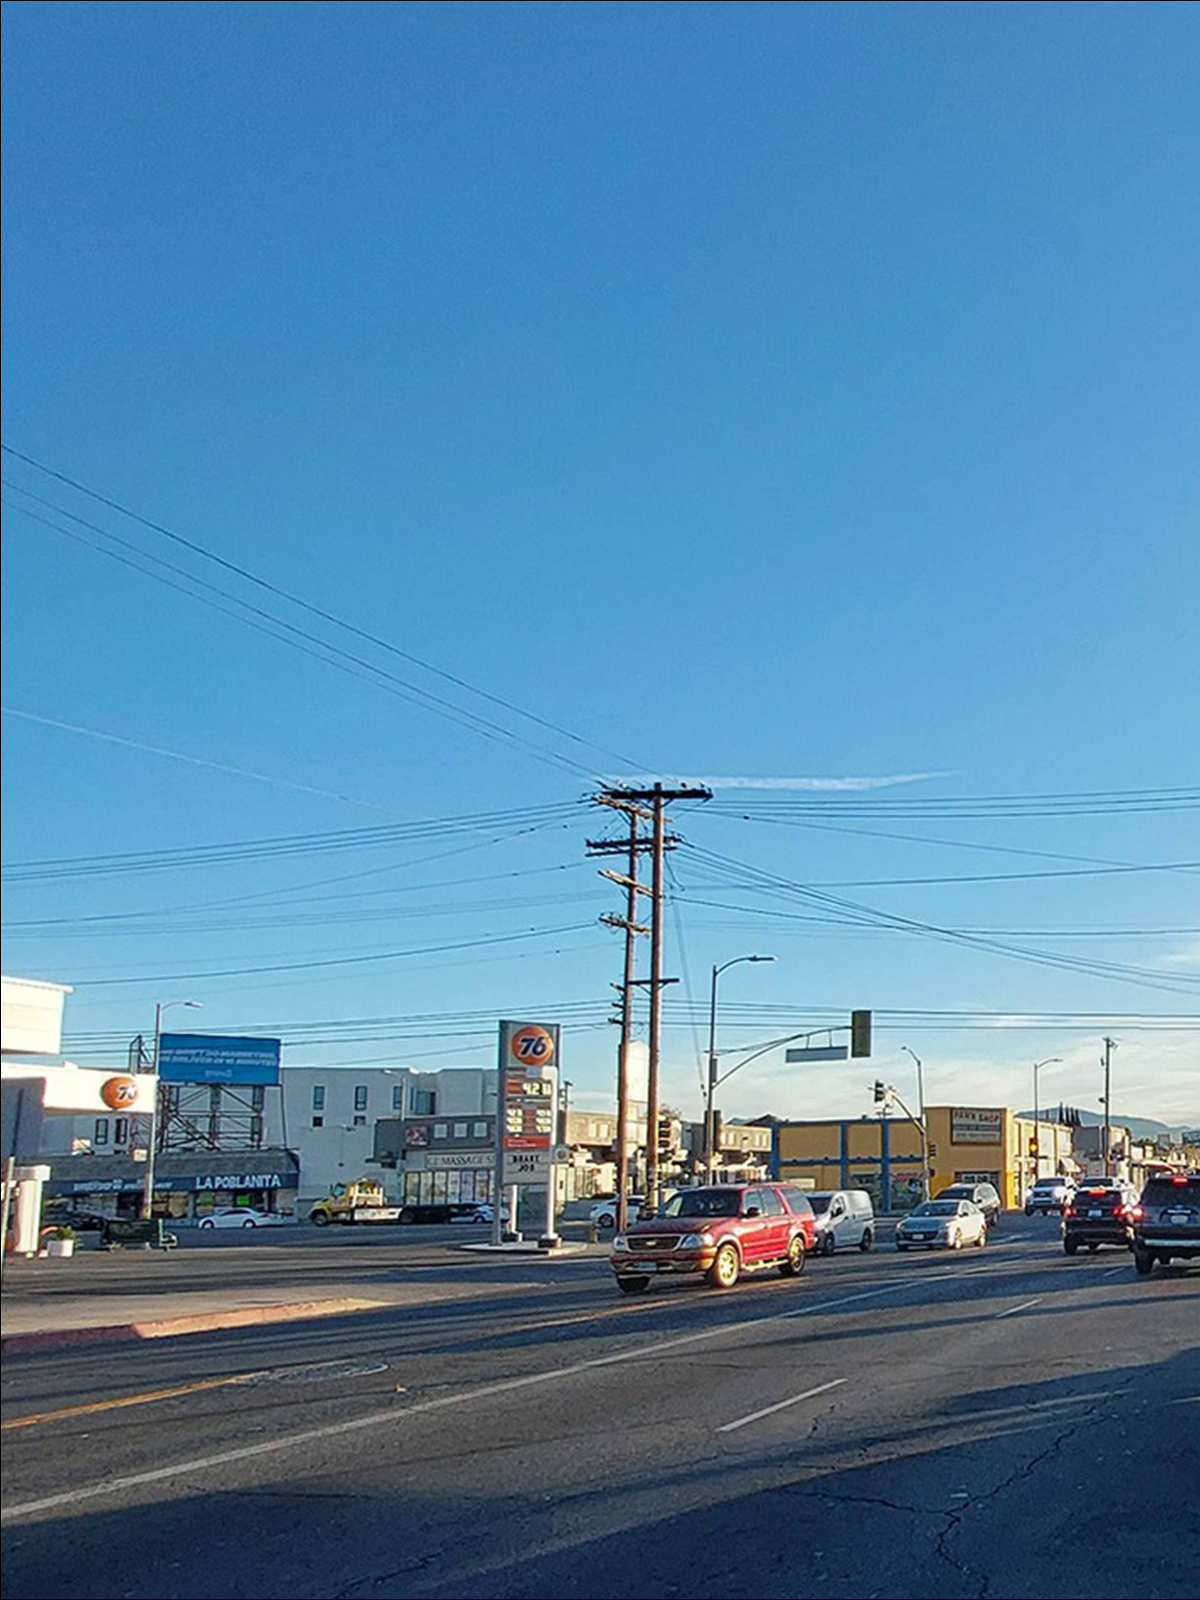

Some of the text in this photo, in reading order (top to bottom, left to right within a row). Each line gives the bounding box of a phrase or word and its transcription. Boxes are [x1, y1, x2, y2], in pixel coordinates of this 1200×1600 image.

[517, 1034, 548, 1058] 76
[512, 1154, 540, 1164] BRAKE
[518, 1164, 535, 1173] JOB
[195, 1174, 282, 1190] LA POBLANITA
